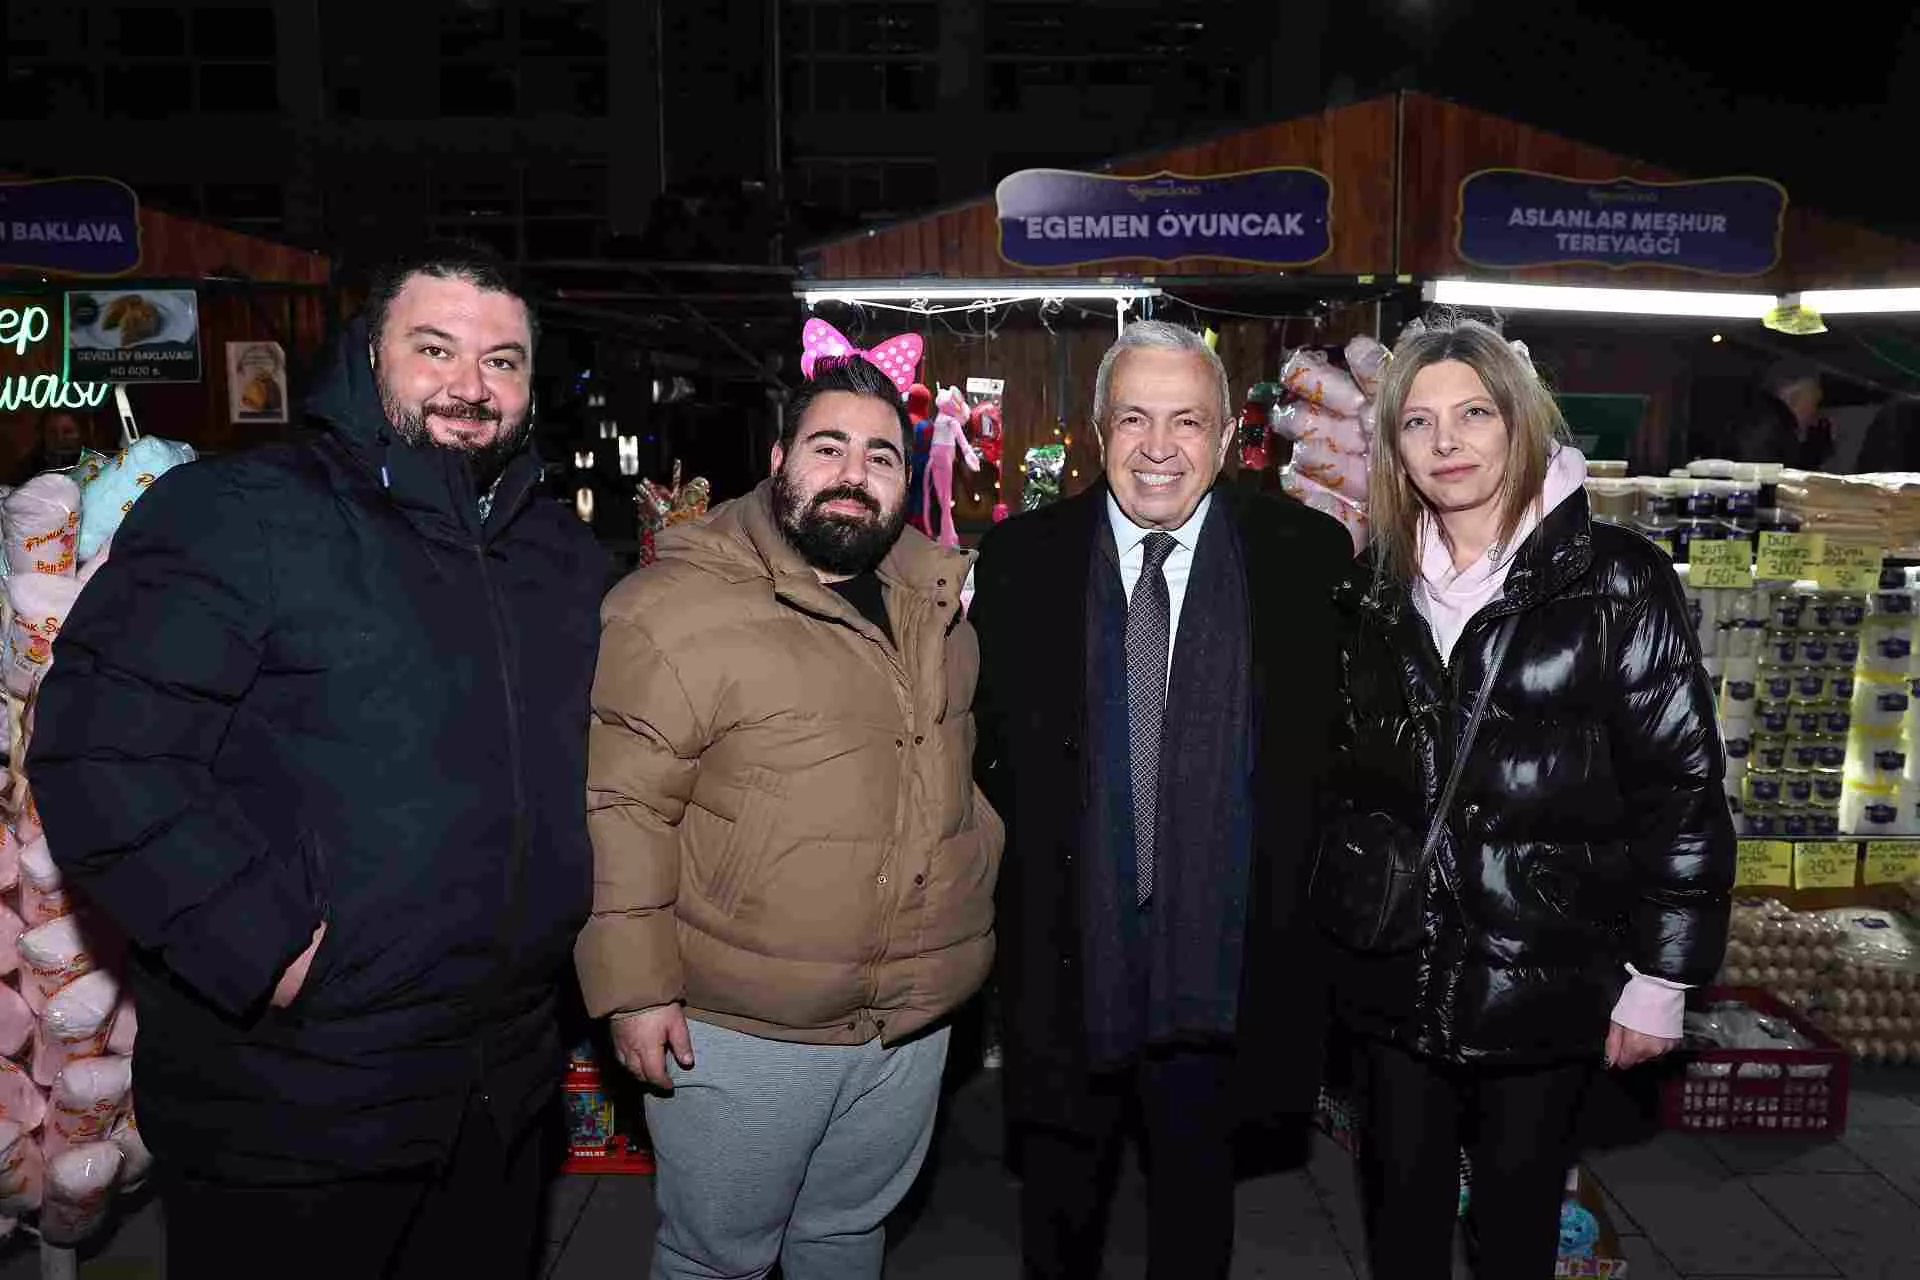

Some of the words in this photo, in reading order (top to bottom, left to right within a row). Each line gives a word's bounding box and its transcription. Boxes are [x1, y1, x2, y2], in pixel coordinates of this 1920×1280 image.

[11, 221, 124, 242] BAKLAVA
[1026, 215, 1148, 240] EGEMEN
[1157, 213, 1304, 238] OYUNCAK
[1508, 208, 1627, 230] ASLANLAR
[1631, 211, 1727, 236] MEŞHUR
[0, 374, 108, 411] vası
